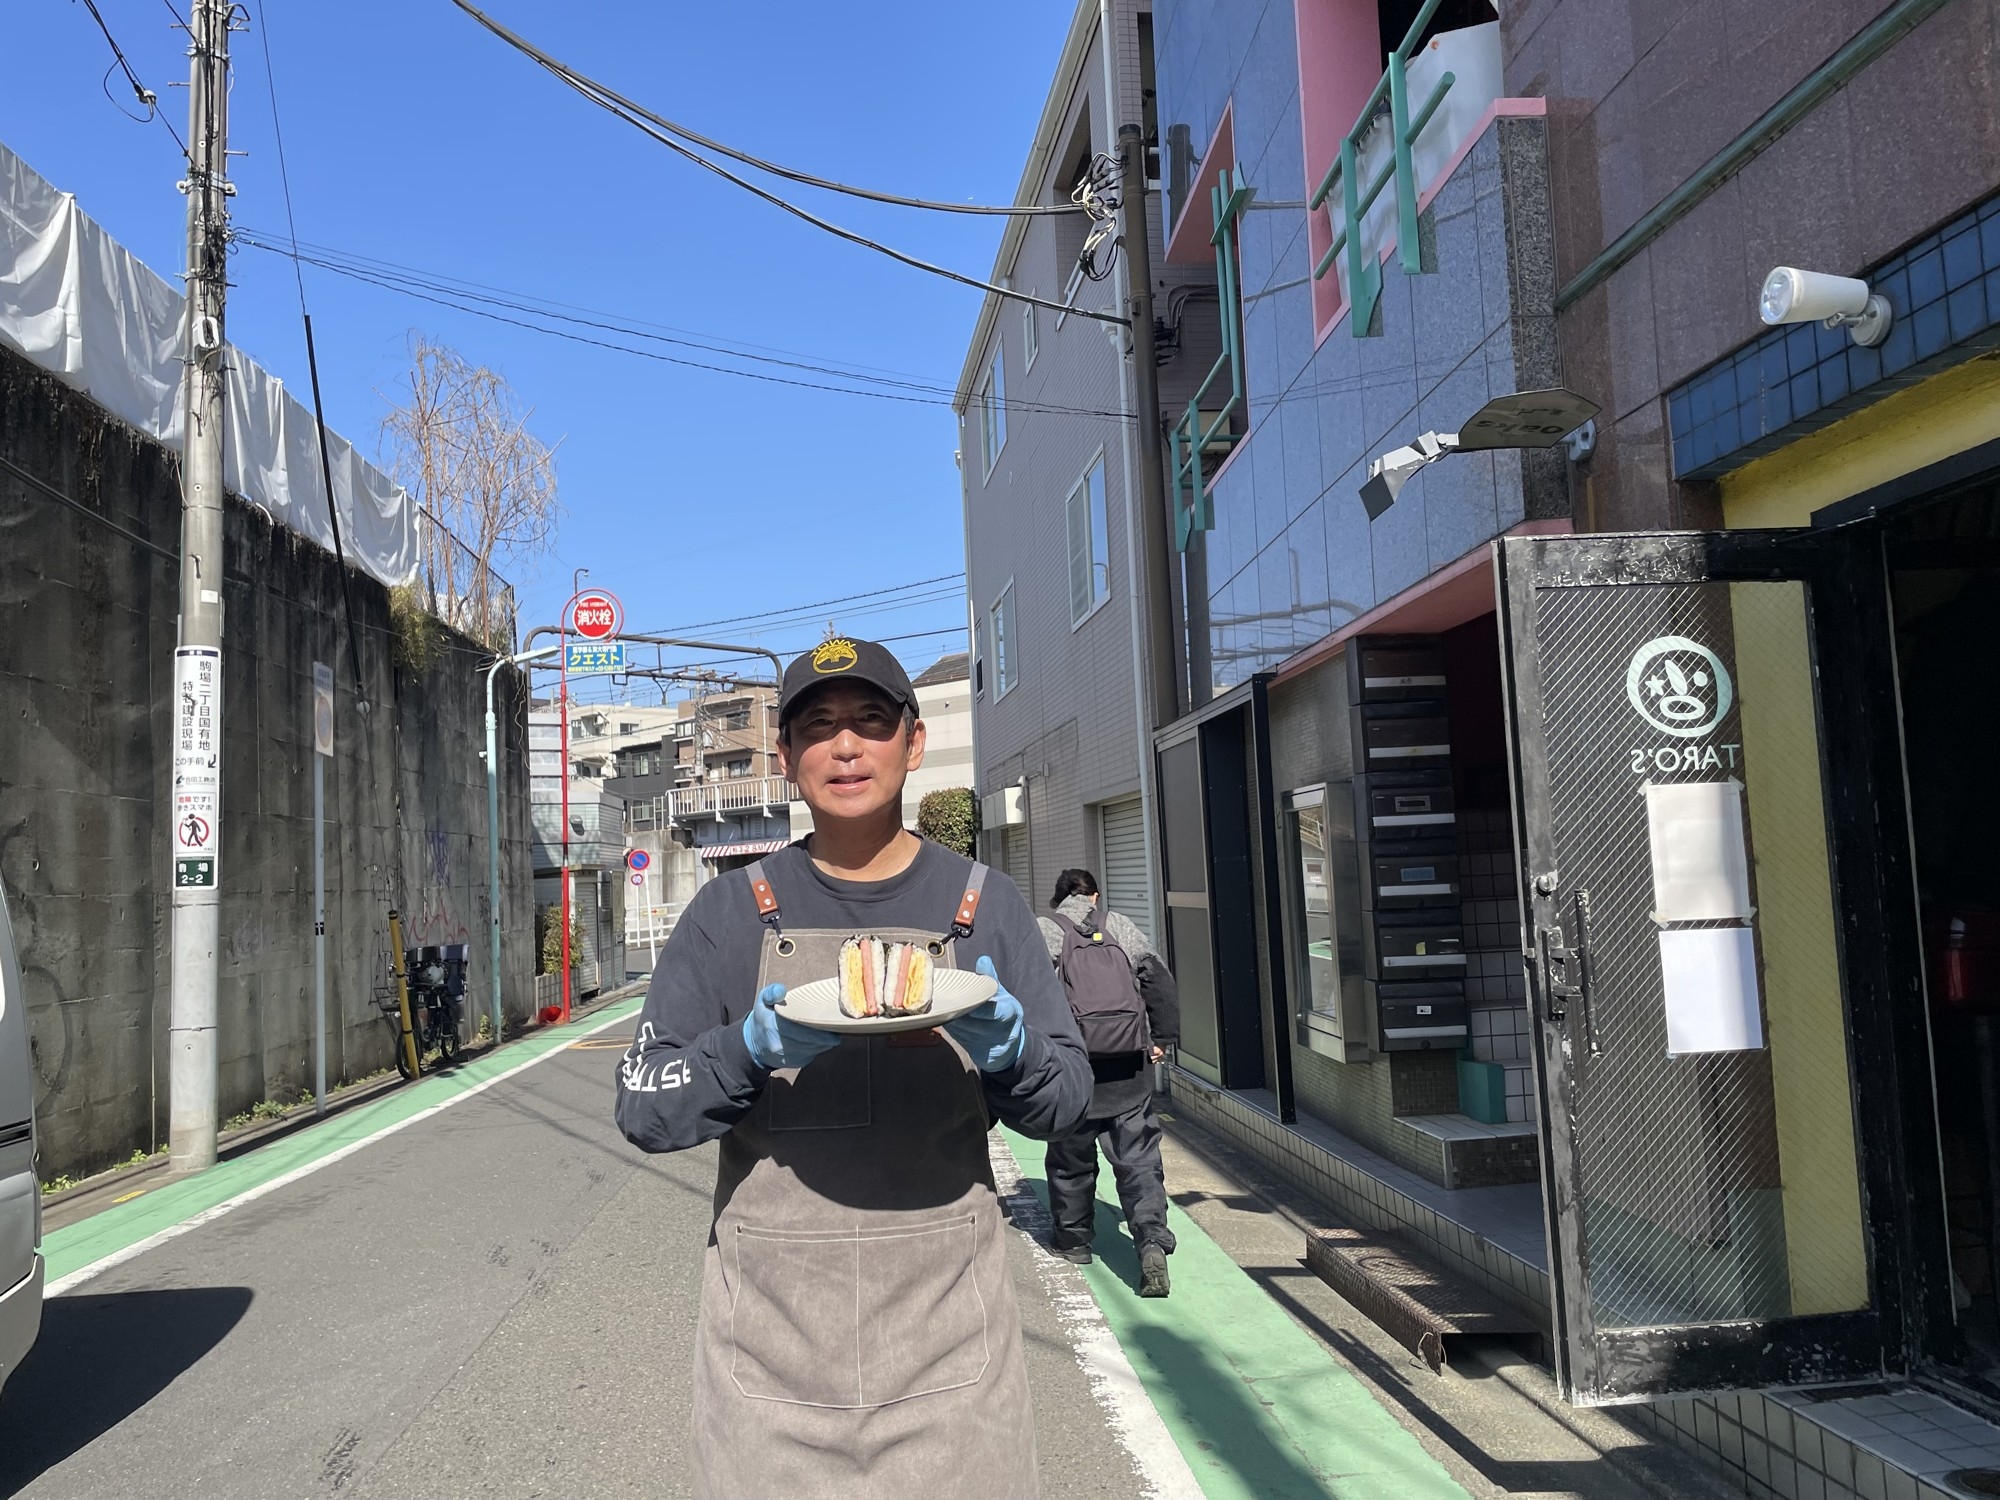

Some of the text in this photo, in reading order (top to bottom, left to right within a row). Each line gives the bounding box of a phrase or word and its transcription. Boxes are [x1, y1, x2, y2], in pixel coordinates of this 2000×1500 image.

[577, 609, 611, 626] 消火栓
[570, 653, 620, 665] クエスト
[198, 660, 212, 751] 駒場二丁目国有地
[175, 757, 205, 766] この手前
[181, 874, 204, 884] 2-2
